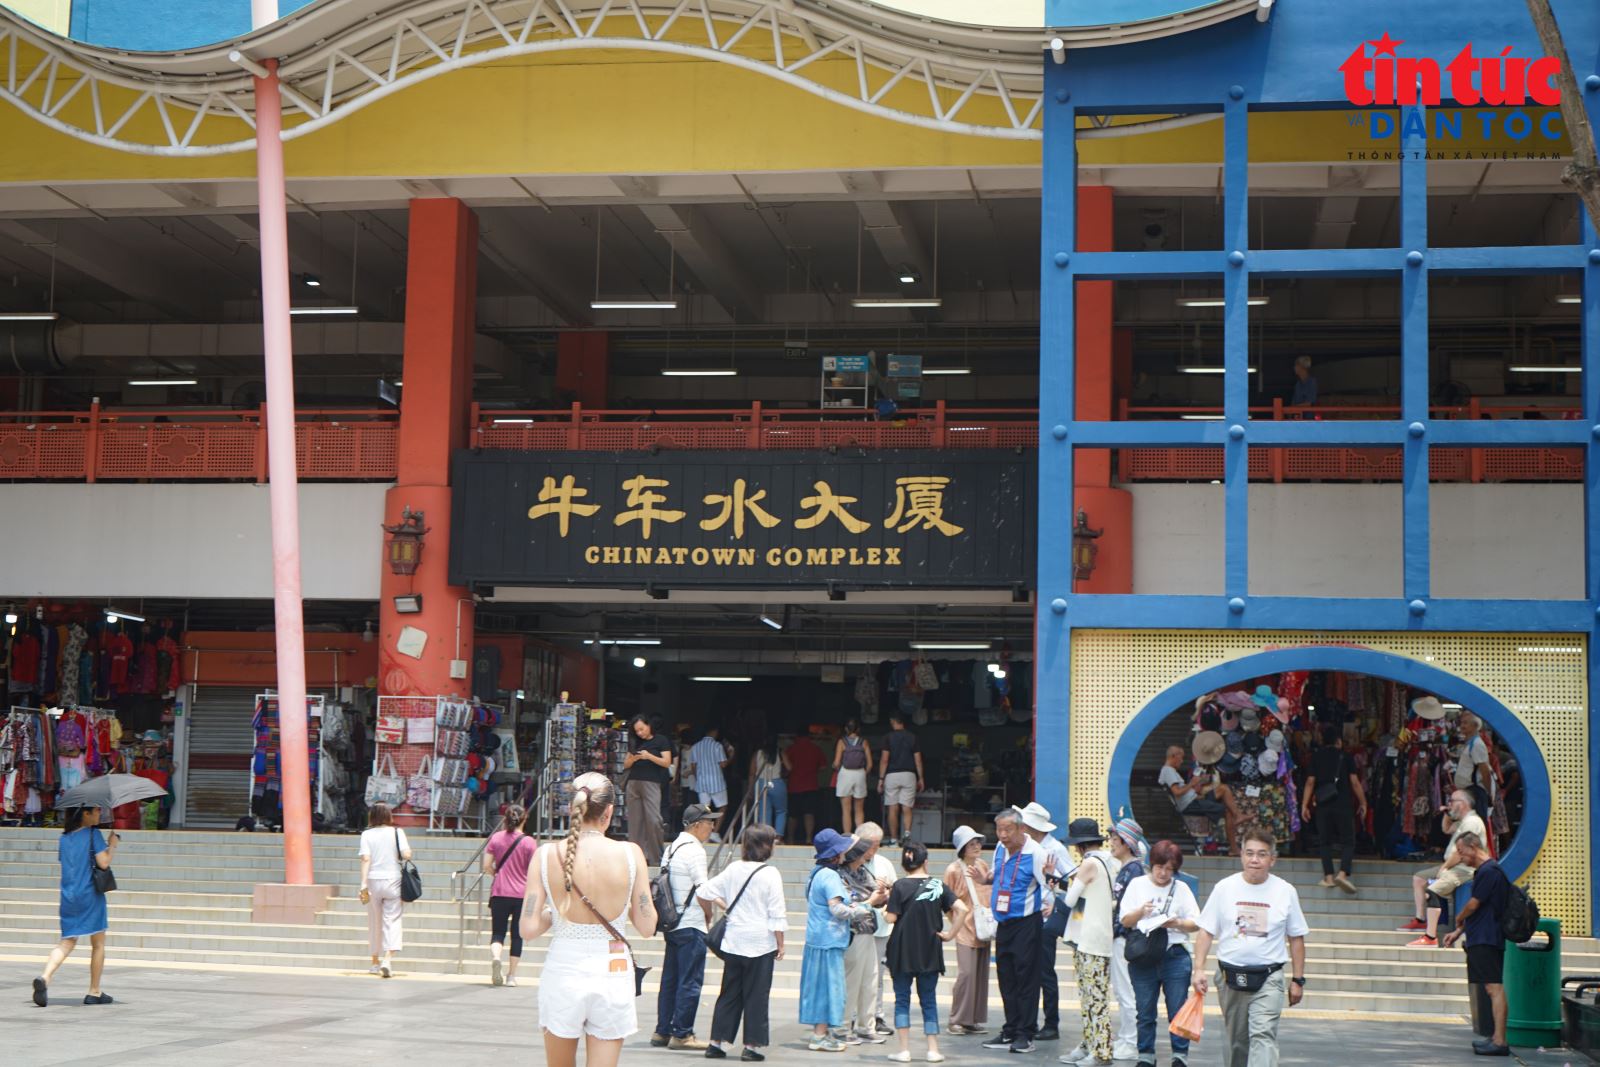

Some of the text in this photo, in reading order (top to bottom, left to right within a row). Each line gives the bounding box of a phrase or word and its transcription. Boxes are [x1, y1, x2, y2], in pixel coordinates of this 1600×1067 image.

[528, 475, 964, 539] 牛车水大厦
[585, 546, 902, 566] CHINATOWN COMPLEX
